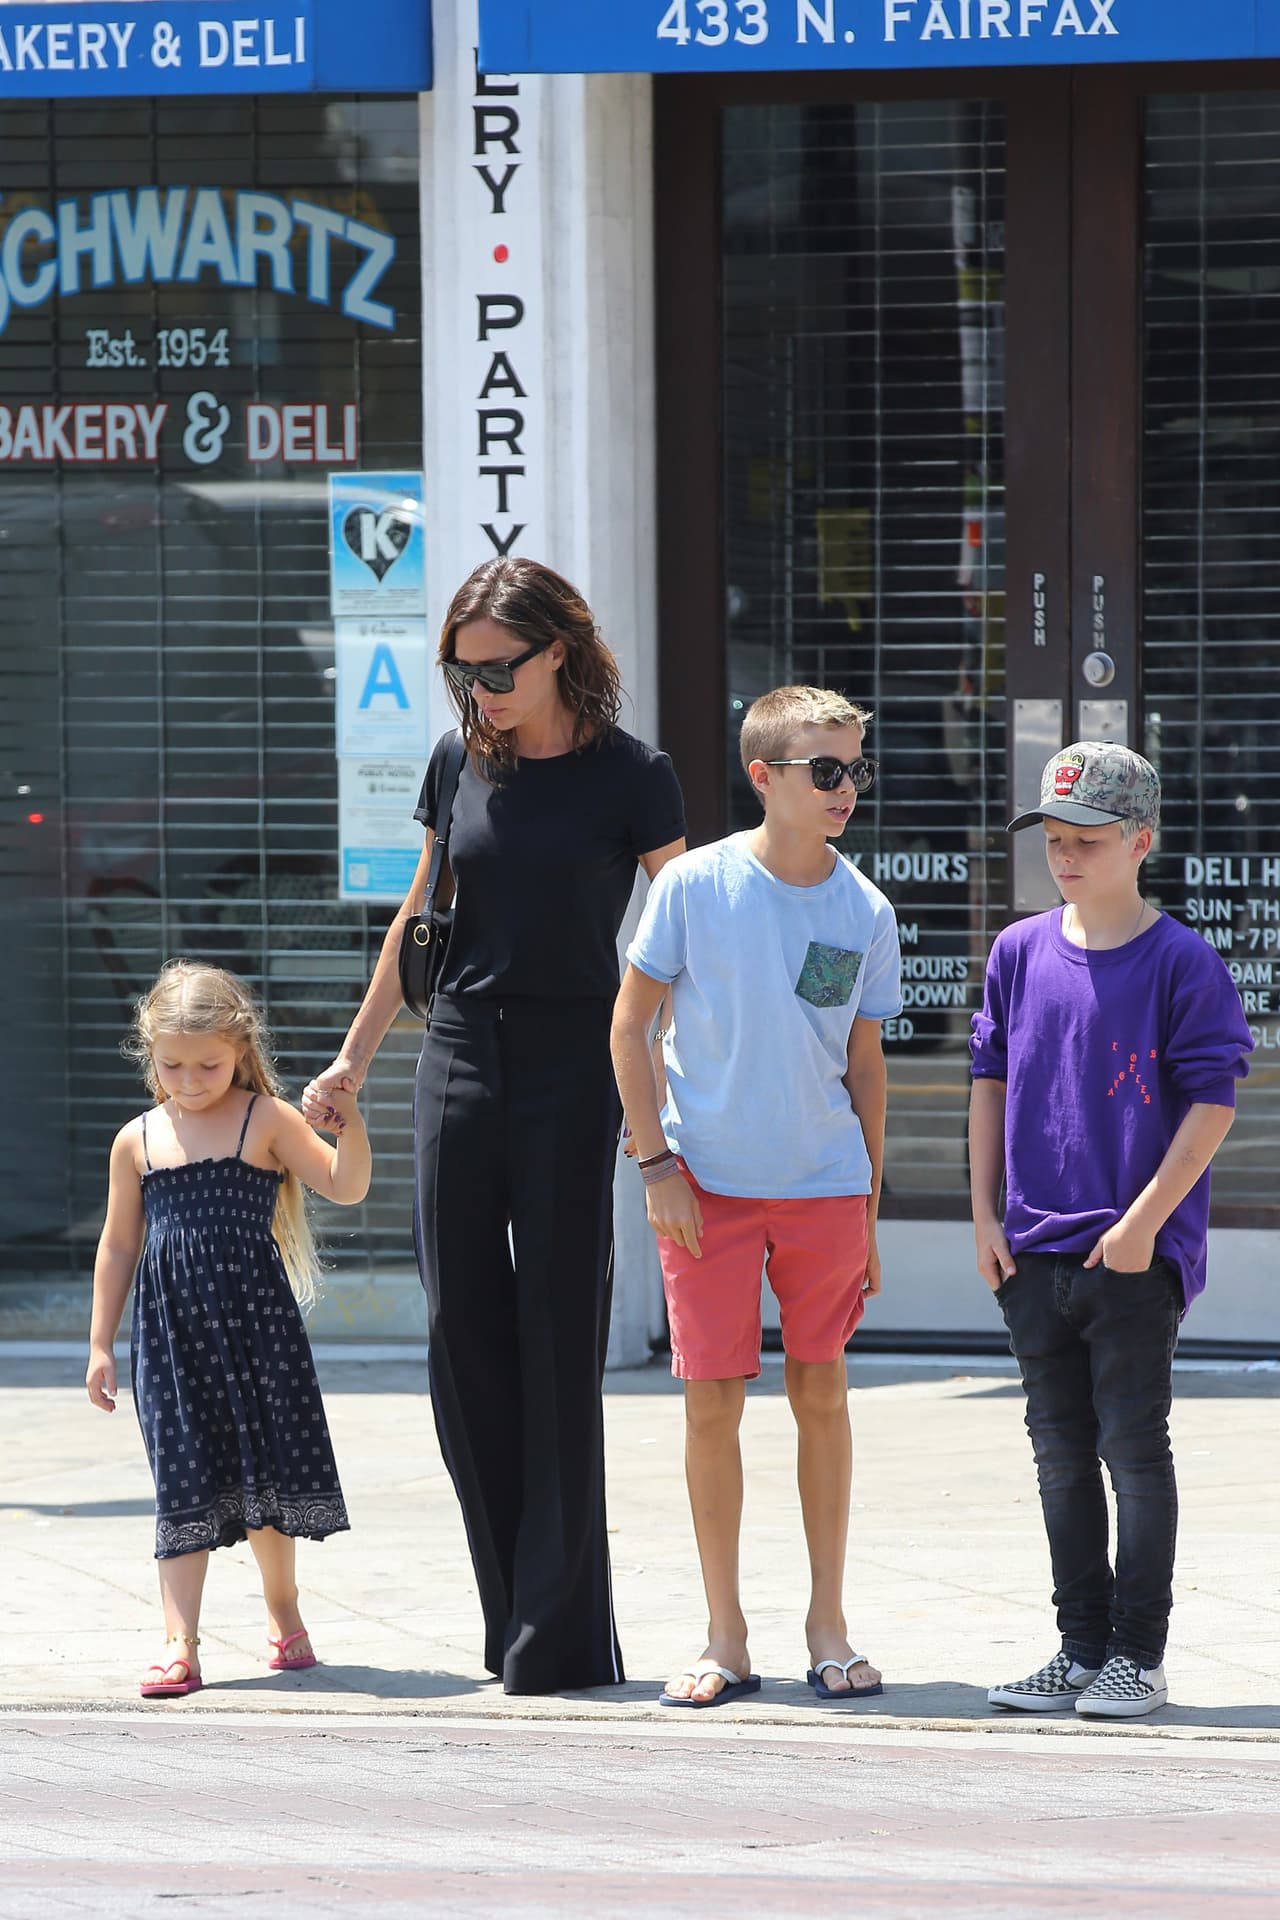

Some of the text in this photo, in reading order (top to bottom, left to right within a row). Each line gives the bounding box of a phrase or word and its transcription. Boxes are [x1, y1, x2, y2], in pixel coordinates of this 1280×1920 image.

[151, 21, 181, 67] &
[198, 16, 305, 67] DELI
[656, 0, 1119, 46] 433 N. FAIRFAX
[0, 183, 397, 336] CHWARTZ
[85, 328, 230, 367] Est. 1954
[183, 391, 230, 464] &
[246, 403, 357, 462] DELI
[475, 294, 528, 557] PARTY
[361, 511, 400, 560] K
[1033, 573, 1046, 647] PUSH
[1093, 575, 1105, 649] PUSH
[358, 641, 411, 709] A
[874, 853, 968, 882] HOURS
[1184, 856, 1250, 886] DELI
[901, 957, 968, 980] HOURS
[880, 1017, 914, 1041] ED
